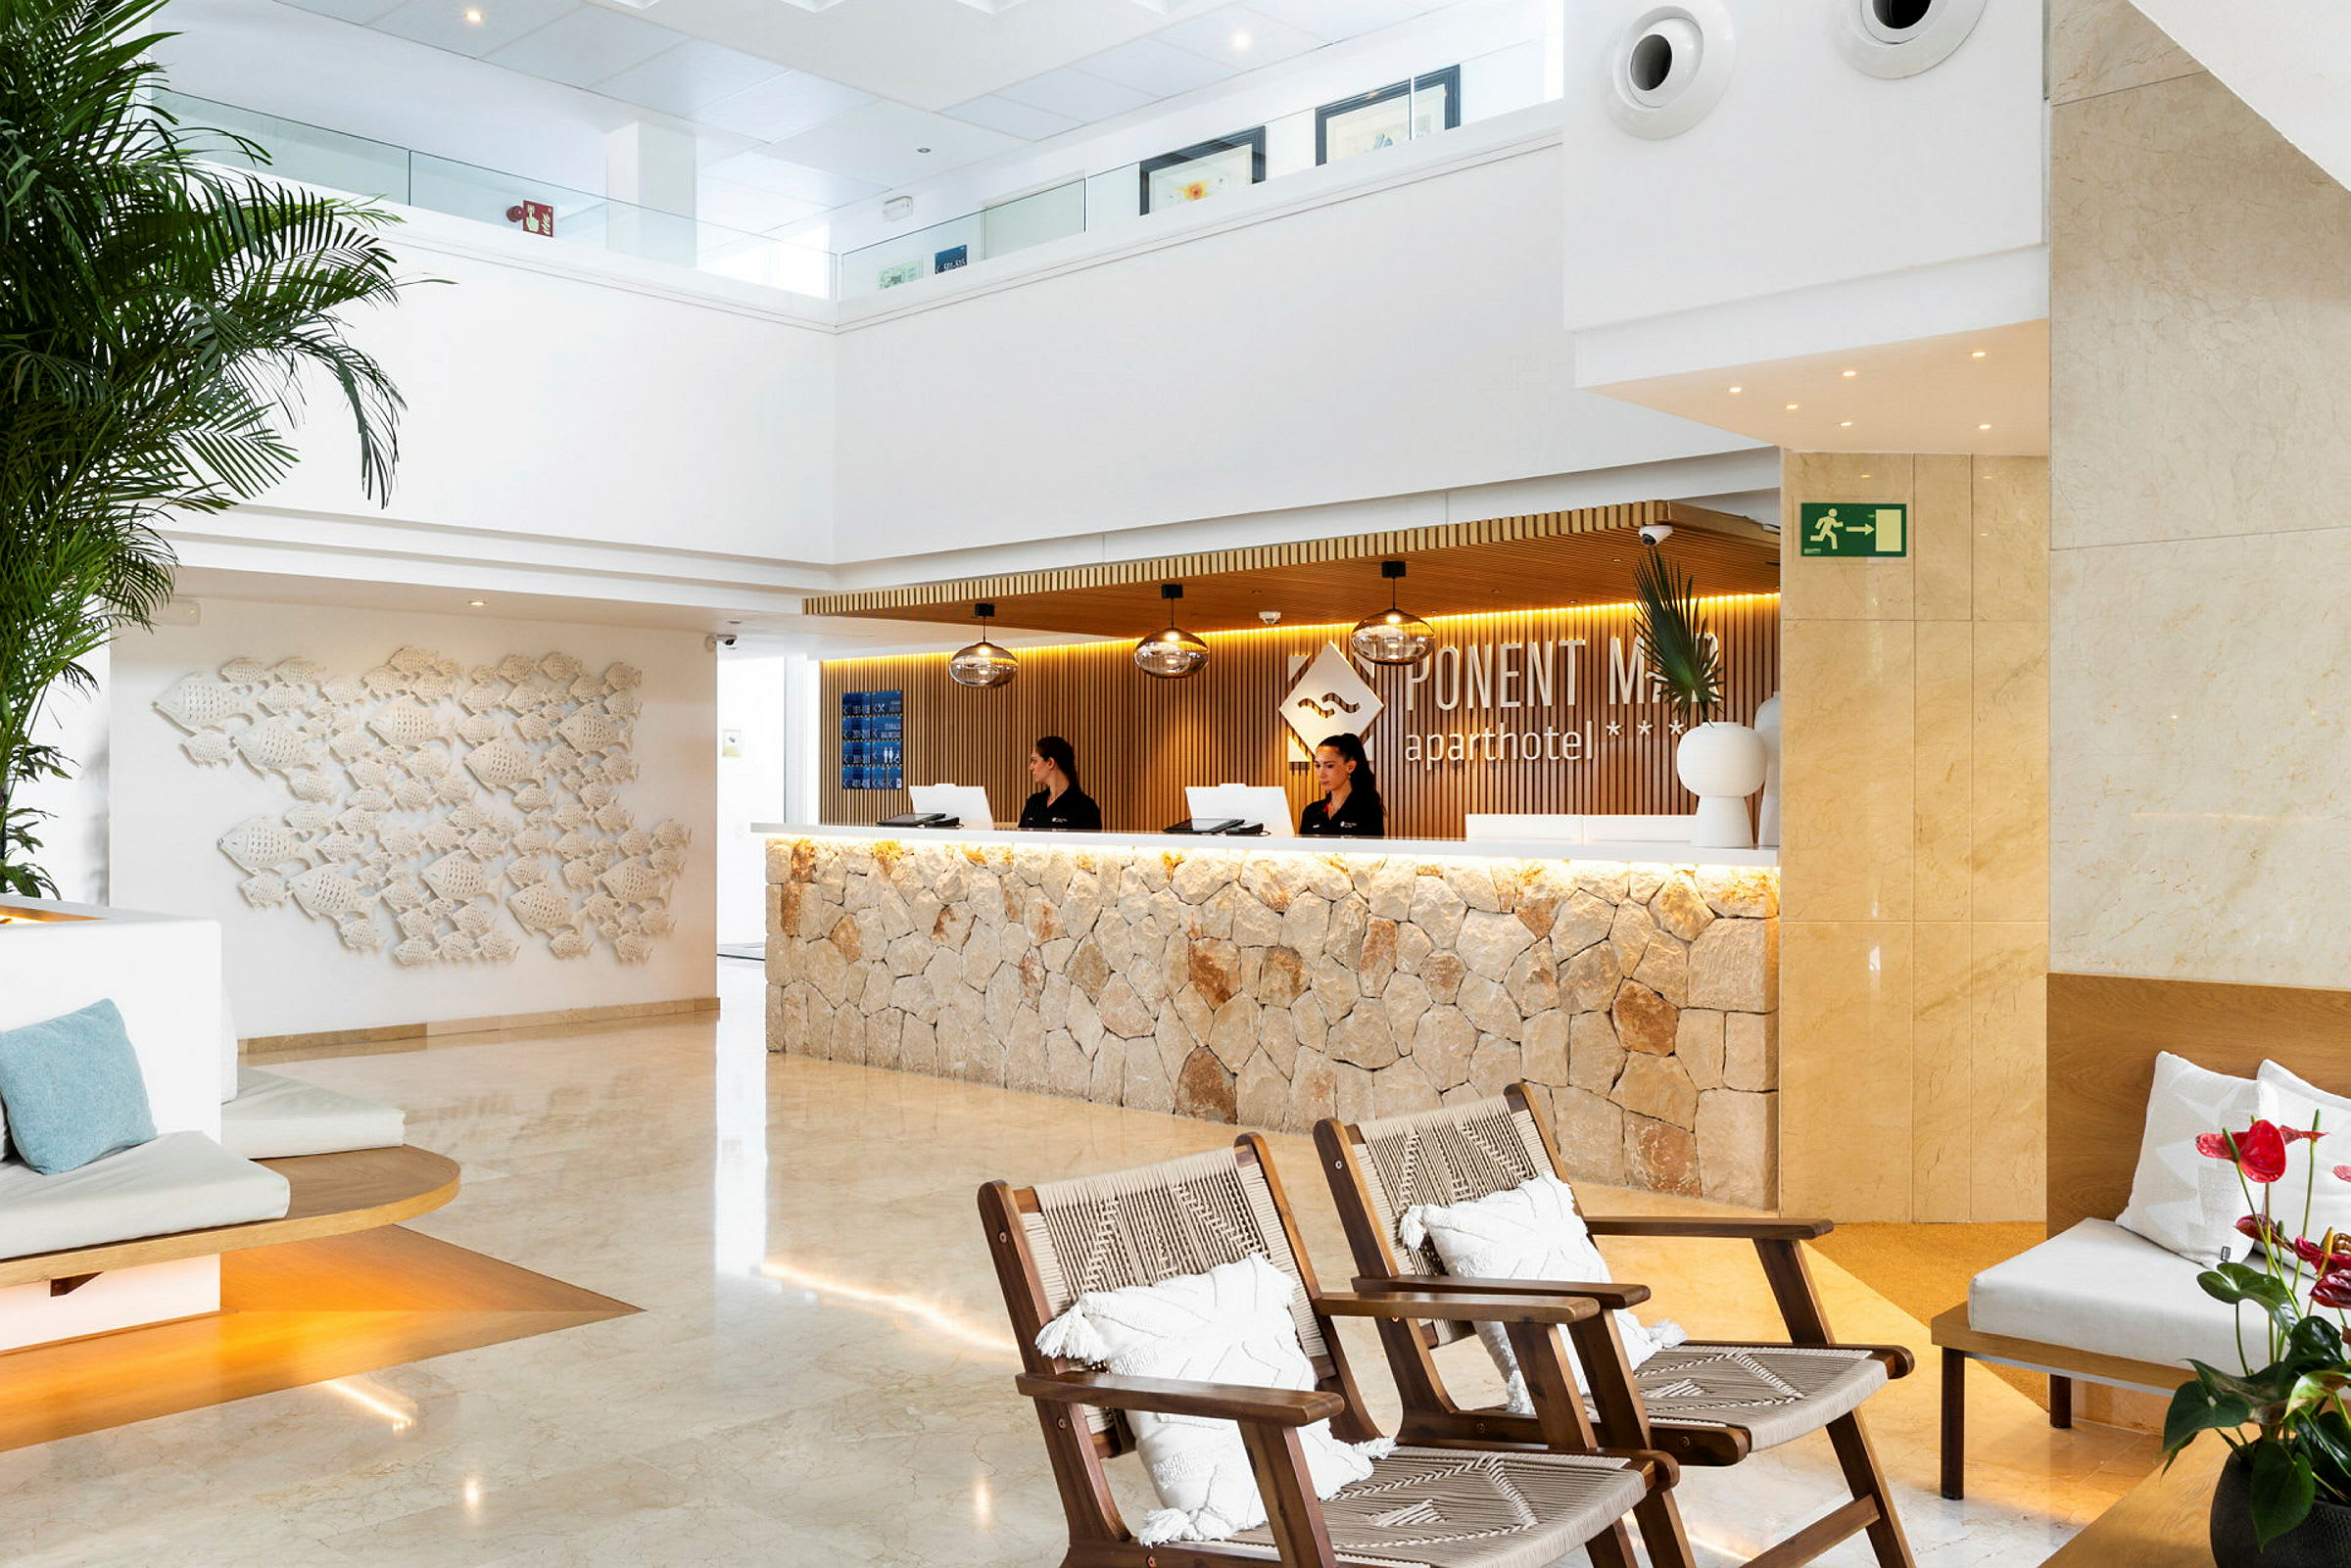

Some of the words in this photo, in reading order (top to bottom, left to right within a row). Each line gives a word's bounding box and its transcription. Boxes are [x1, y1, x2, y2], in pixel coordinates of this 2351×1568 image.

[1406, 639, 1586, 711] PONENT
[1608, 633, 1722, 704] MR
[1405, 720, 1594, 771] aparthotel
